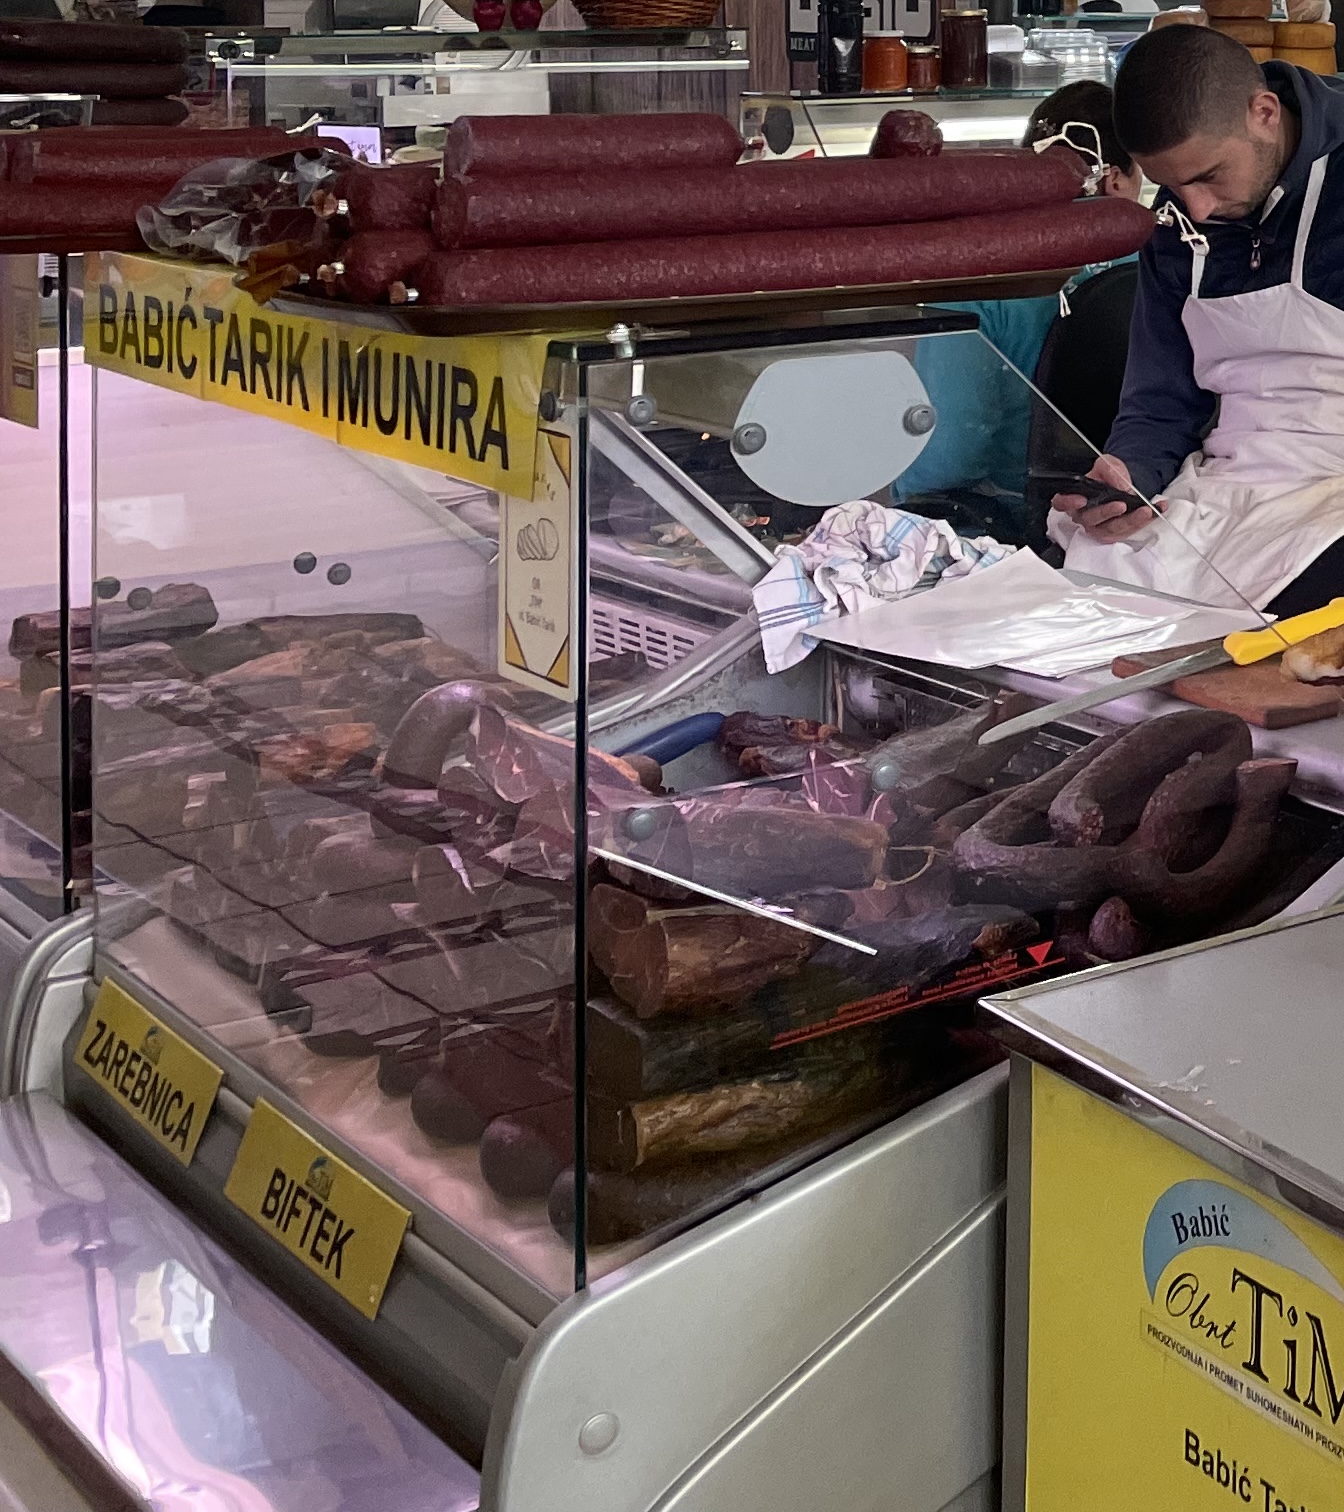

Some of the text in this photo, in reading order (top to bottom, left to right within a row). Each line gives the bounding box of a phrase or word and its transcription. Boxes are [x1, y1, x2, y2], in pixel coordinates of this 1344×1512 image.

[100, 284, 199, 381] BABIĆ
[203, 307, 310, 413] TARIK
[321, 337, 330, 419] I
[337, 339, 510, 472] MUNIRA
[83, 1019, 195, 1153] ZAREBNICA
[260, 1167, 355, 1280] BIFTEK
[1170, 1203, 1231, 1246] Babić
[1146, 1323, 1204, 1371] PROIZVODNJA
[1209, 1363, 1244, 1394] PROMET
[1245, 1386, 1314, 1439] SUHOMESNATIH
[1184, 1428, 1252, 1504] Babić
